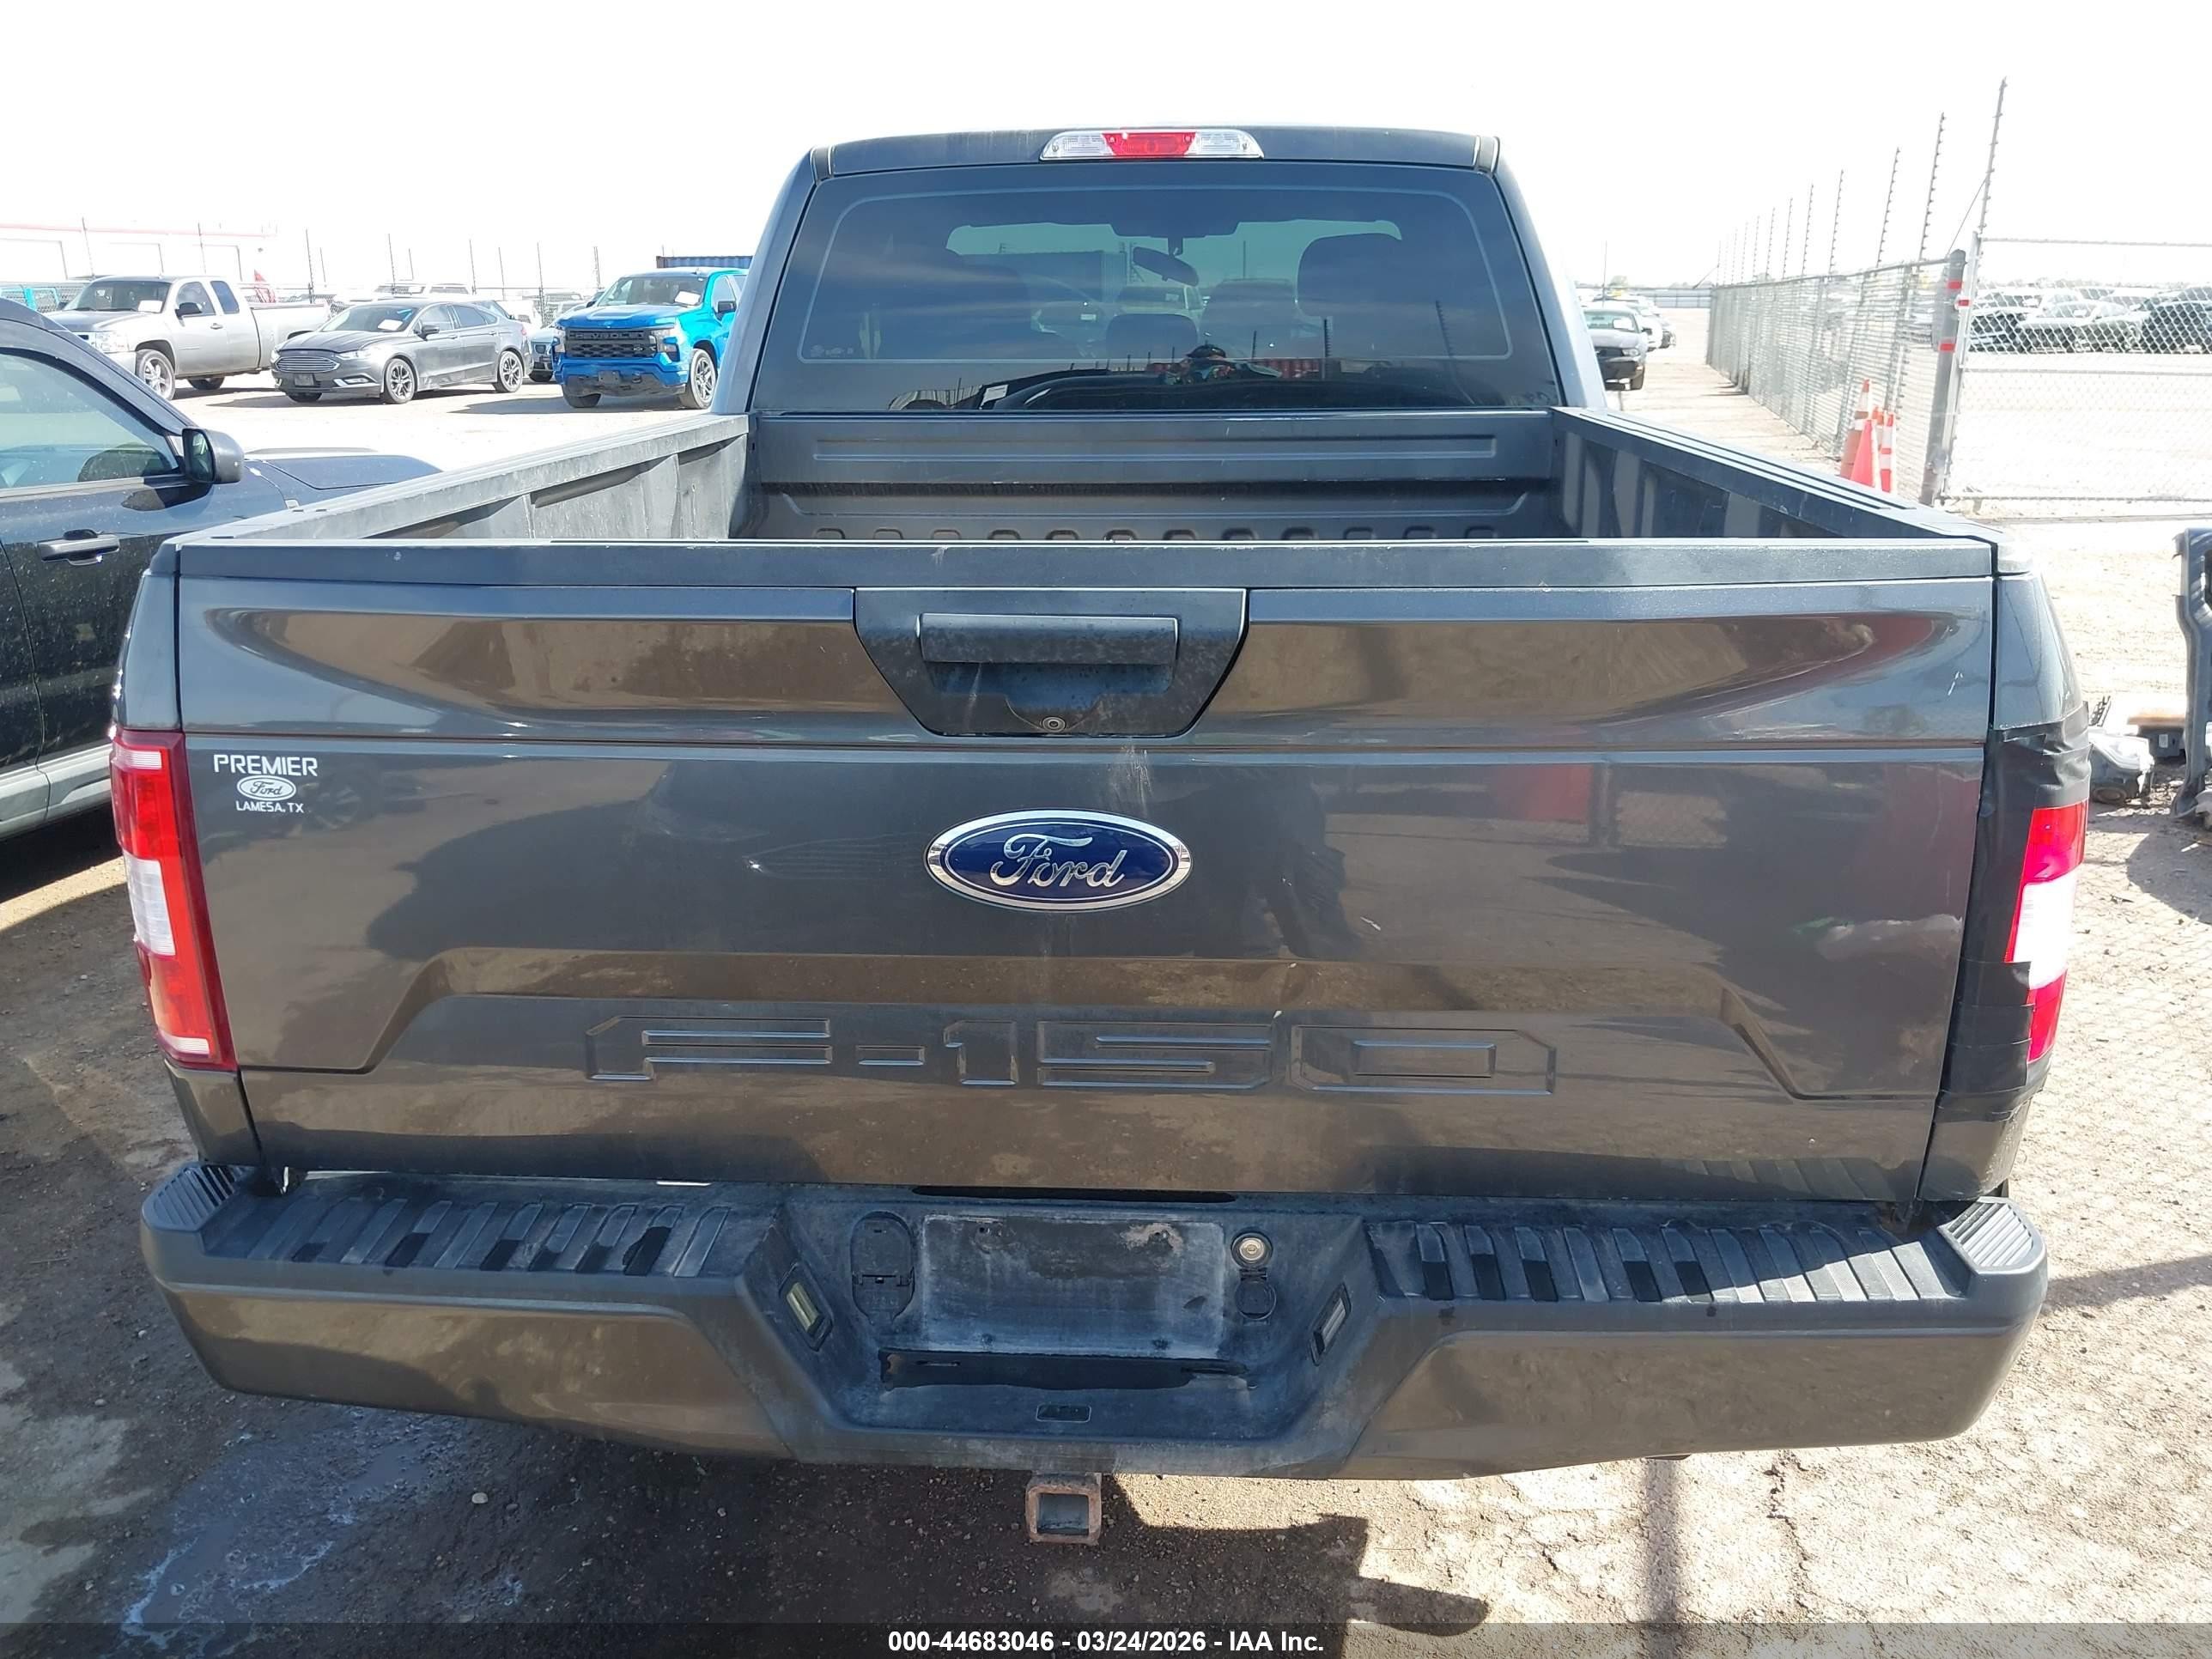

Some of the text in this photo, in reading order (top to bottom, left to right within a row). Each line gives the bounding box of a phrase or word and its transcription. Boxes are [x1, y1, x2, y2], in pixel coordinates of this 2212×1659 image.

[214, 754, 319, 776] PREMIER
[249, 781, 283, 796] Ford
[990, 833, 1127, 888] Ford
[587, 1017, 1557, 1096] F-150
